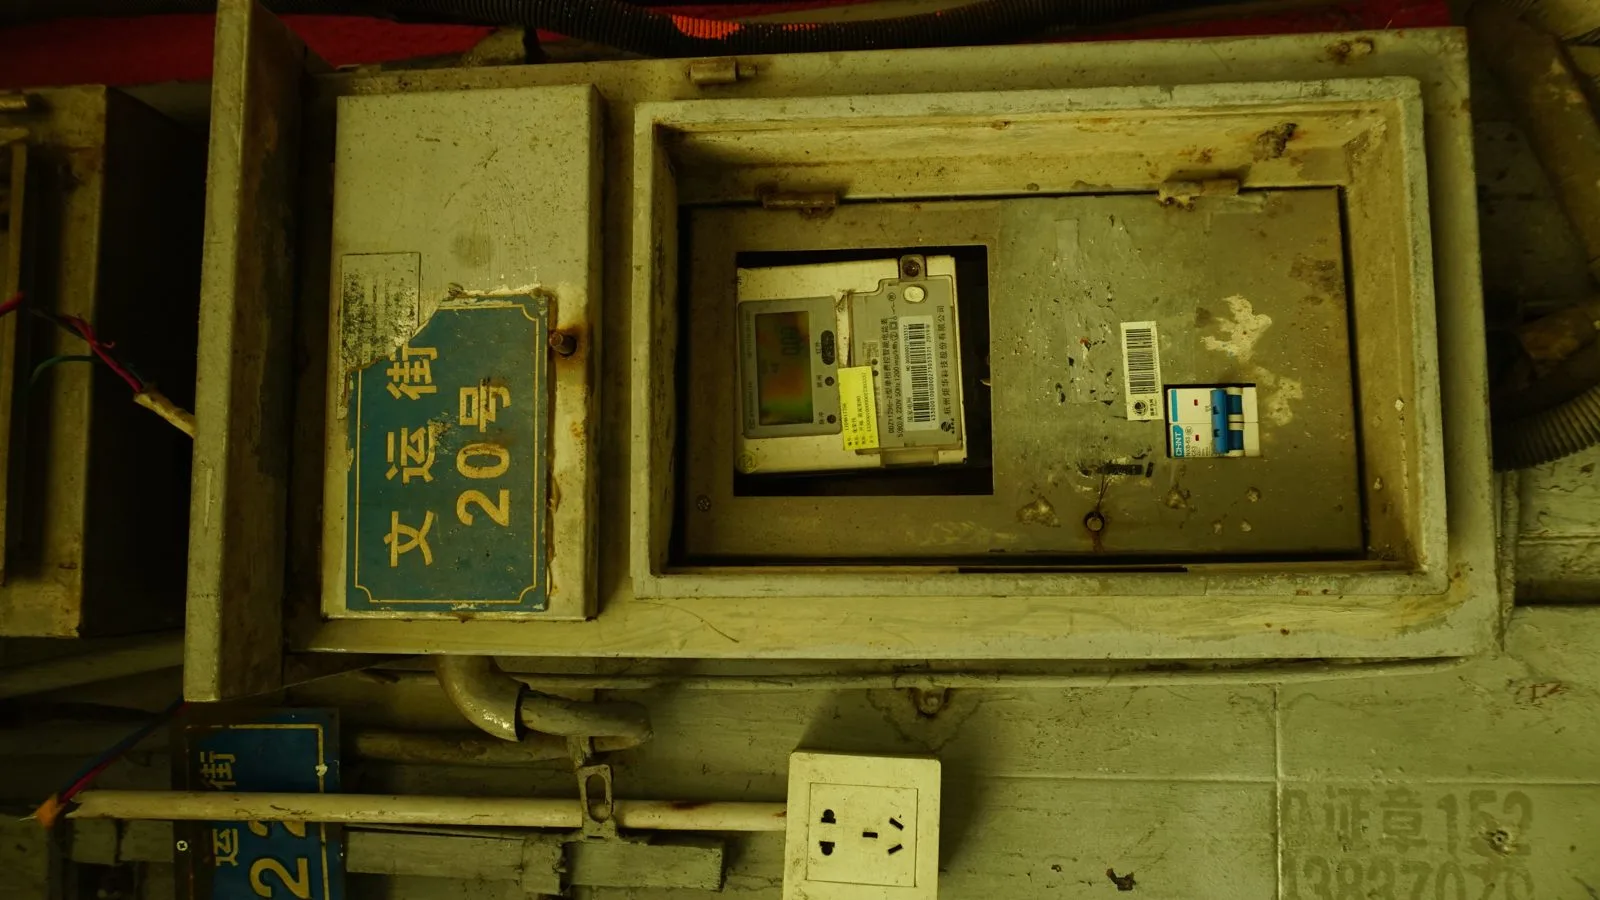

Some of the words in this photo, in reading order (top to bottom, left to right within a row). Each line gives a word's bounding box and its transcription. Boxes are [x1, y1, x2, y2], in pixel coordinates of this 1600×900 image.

[383, 346, 438, 568] 文运街
[456, 378, 512, 528] 20号
